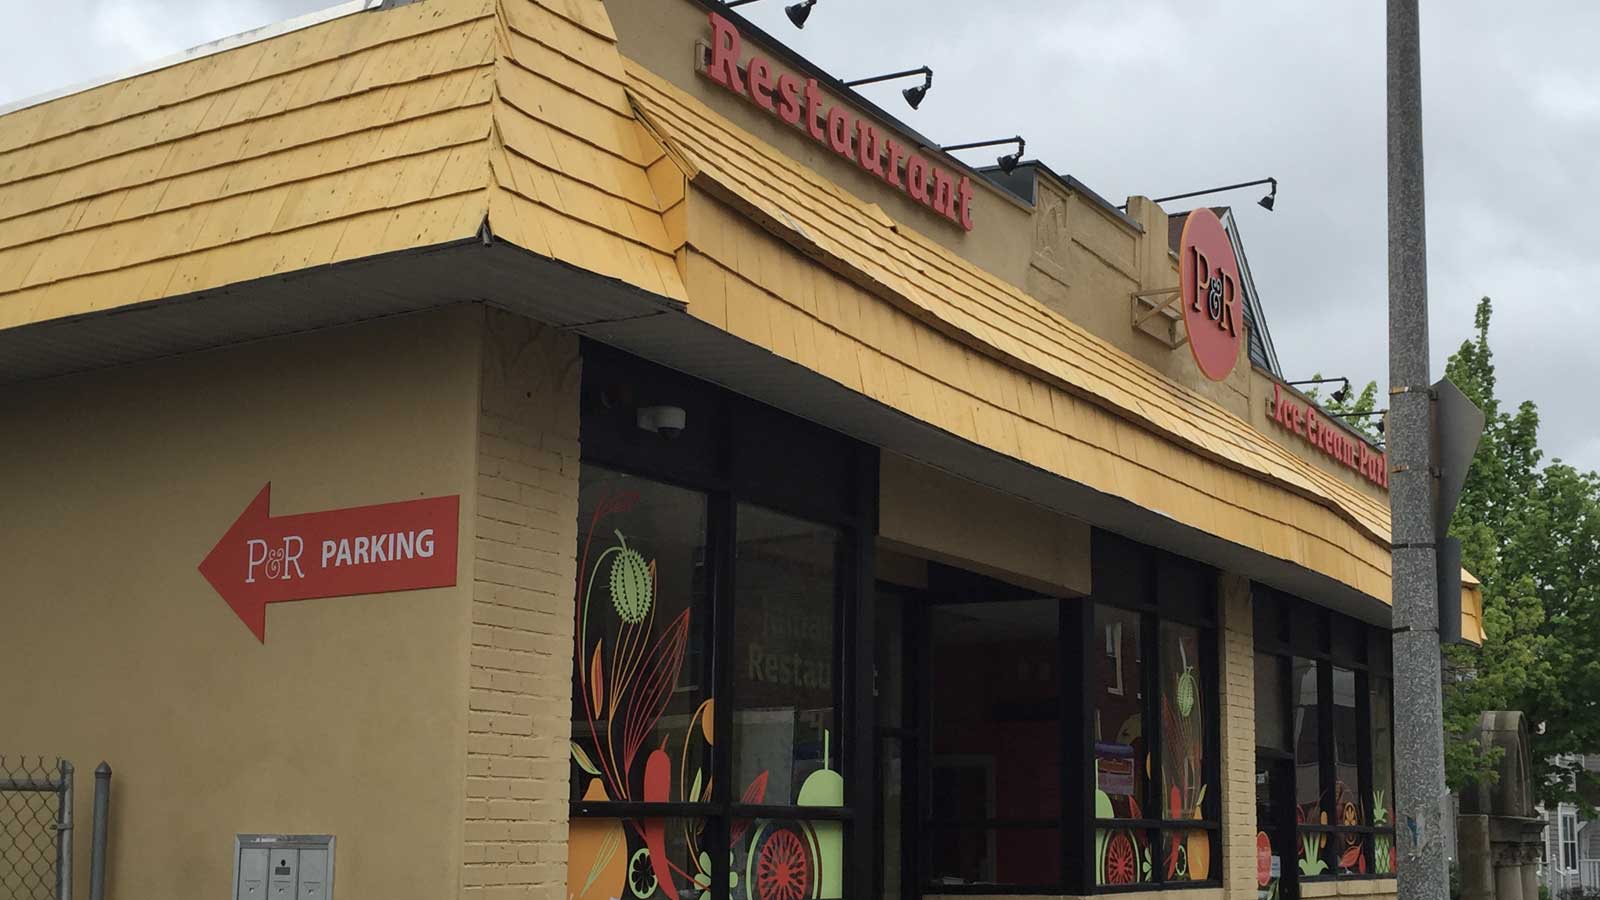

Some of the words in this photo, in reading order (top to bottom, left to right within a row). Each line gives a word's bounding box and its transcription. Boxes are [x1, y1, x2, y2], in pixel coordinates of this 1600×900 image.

[707, 11, 975, 232] Restaurant
[1189, 245, 1236, 338] P&R
[1274, 383, 1301, 435] Ice
[1305, 406, 1354, 467] Cream
[245, 535, 305, 583] P&R
[321, 529, 435, 568] PARKING
